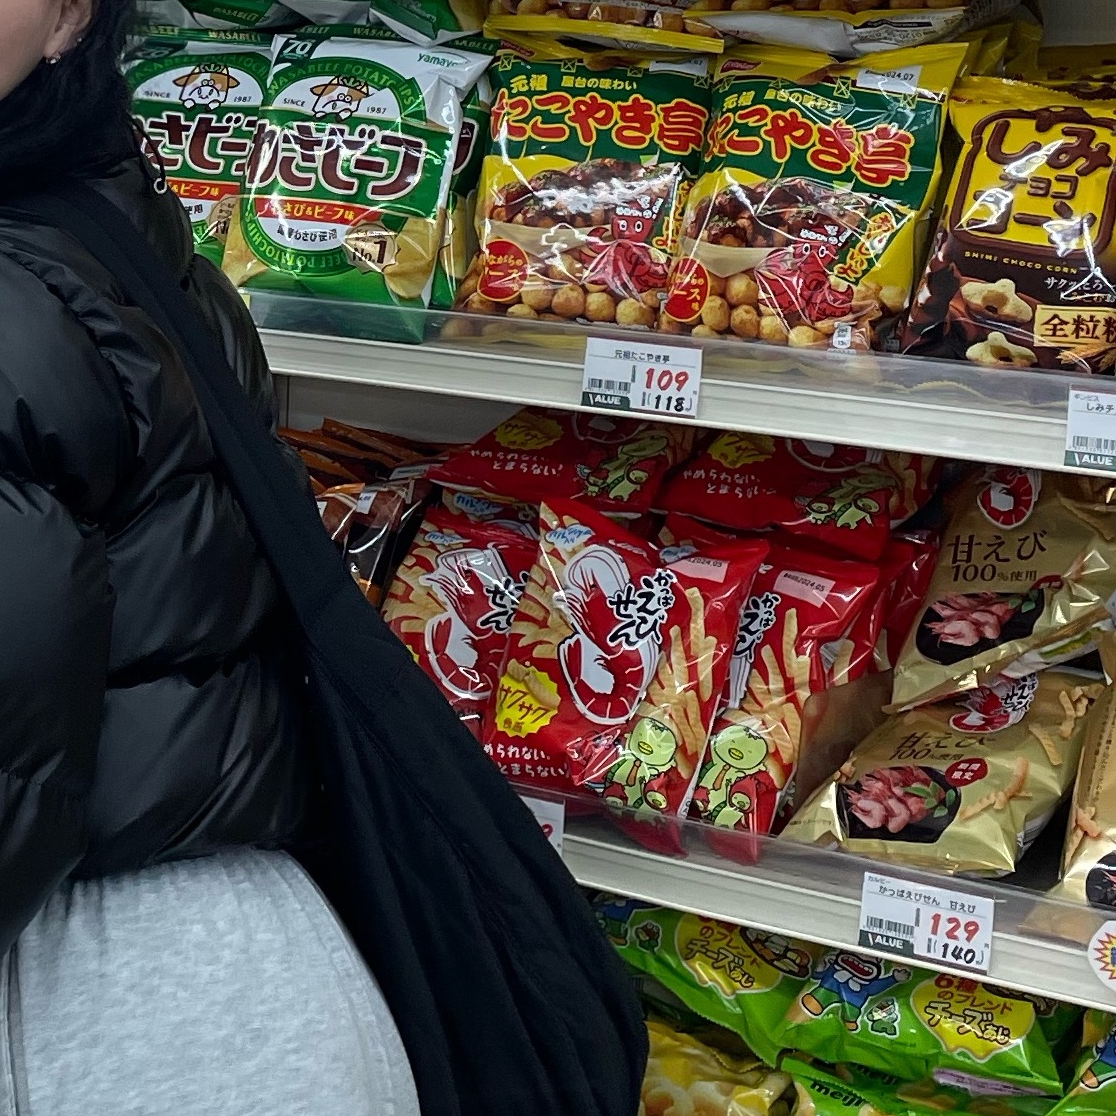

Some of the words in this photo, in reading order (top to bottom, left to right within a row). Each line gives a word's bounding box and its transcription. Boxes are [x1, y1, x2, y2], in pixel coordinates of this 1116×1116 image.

[509, 74, 548, 93] 元祖
[724, 90, 754, 109] 元祖
[366, 106, 388, 115] 1987
[490, 87, 709, 156] たこやき亭
[704, 103, 917, 188] たこやき亭
[986, 119, 1114, 177] しみ
[964, 250, 999, 262] SHIMI
[1002, 256, 1043, 270] CHOCO
[1046, 264, 1078, 275] CORN
[645, 367, 690, 392] 109
[654, 394, 686, 412] 118
[948, 530, 1047, 566] 甘えび
[655, 570, 674, 608] かっぱ
[608, 585, 641, 647] せん
[635, 577, 665, 643] えび
[499, 684, 552, 724] サクサク
[878, 884, 941, 906] かっぱえびせん
[949, 900, 977, 914] 甘えび
[930, 912, 980, 944] 129
[686, 939, 755, 989] チーズあじ
[941, 942, 977, 965] 140
[924, 1000, 1012, 1046] チーズあじ
[810, 1079, 866, 1107] meiji
